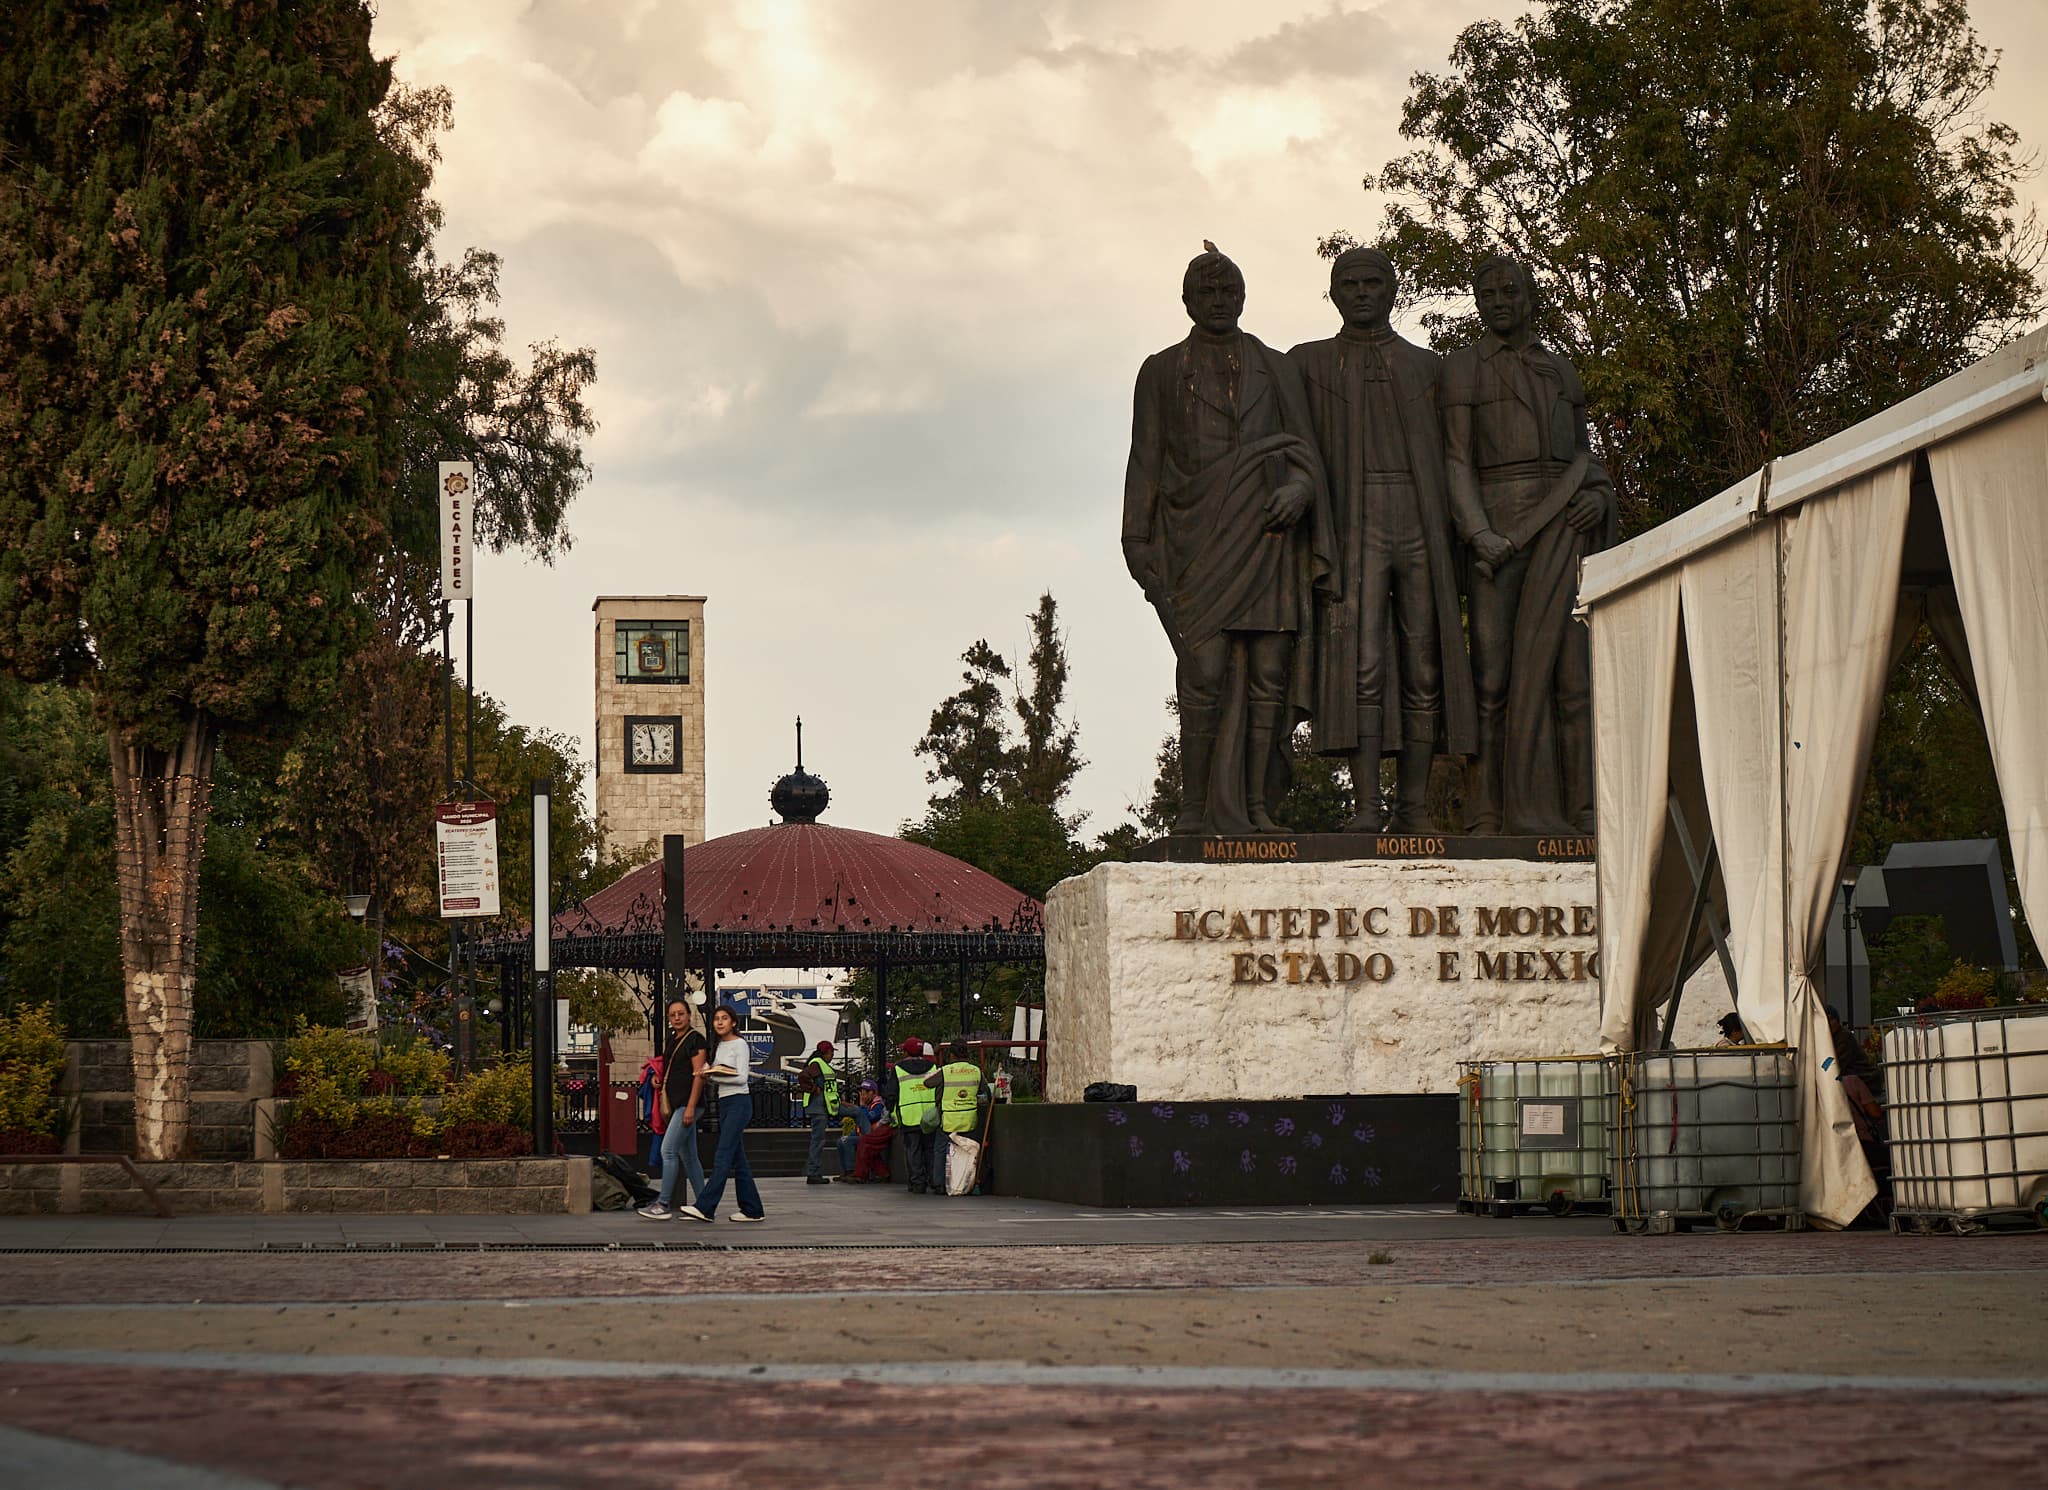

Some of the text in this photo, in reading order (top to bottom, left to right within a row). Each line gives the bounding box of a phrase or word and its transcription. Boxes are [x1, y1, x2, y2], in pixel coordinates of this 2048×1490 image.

[452, 500, 462, 589] ECATEPEC
[1203, 840, 1299, 859] MATAMOROS
[1376, 837, 1446, 856] MORELOS
[1537, 839, 1596, 857] GALEAN
[1172, 905, 1597, 940] ECATEPEC DE MORE
[1231, 951, 1395, 984] ESTADO
[1437, 951, 1462, 981] E
